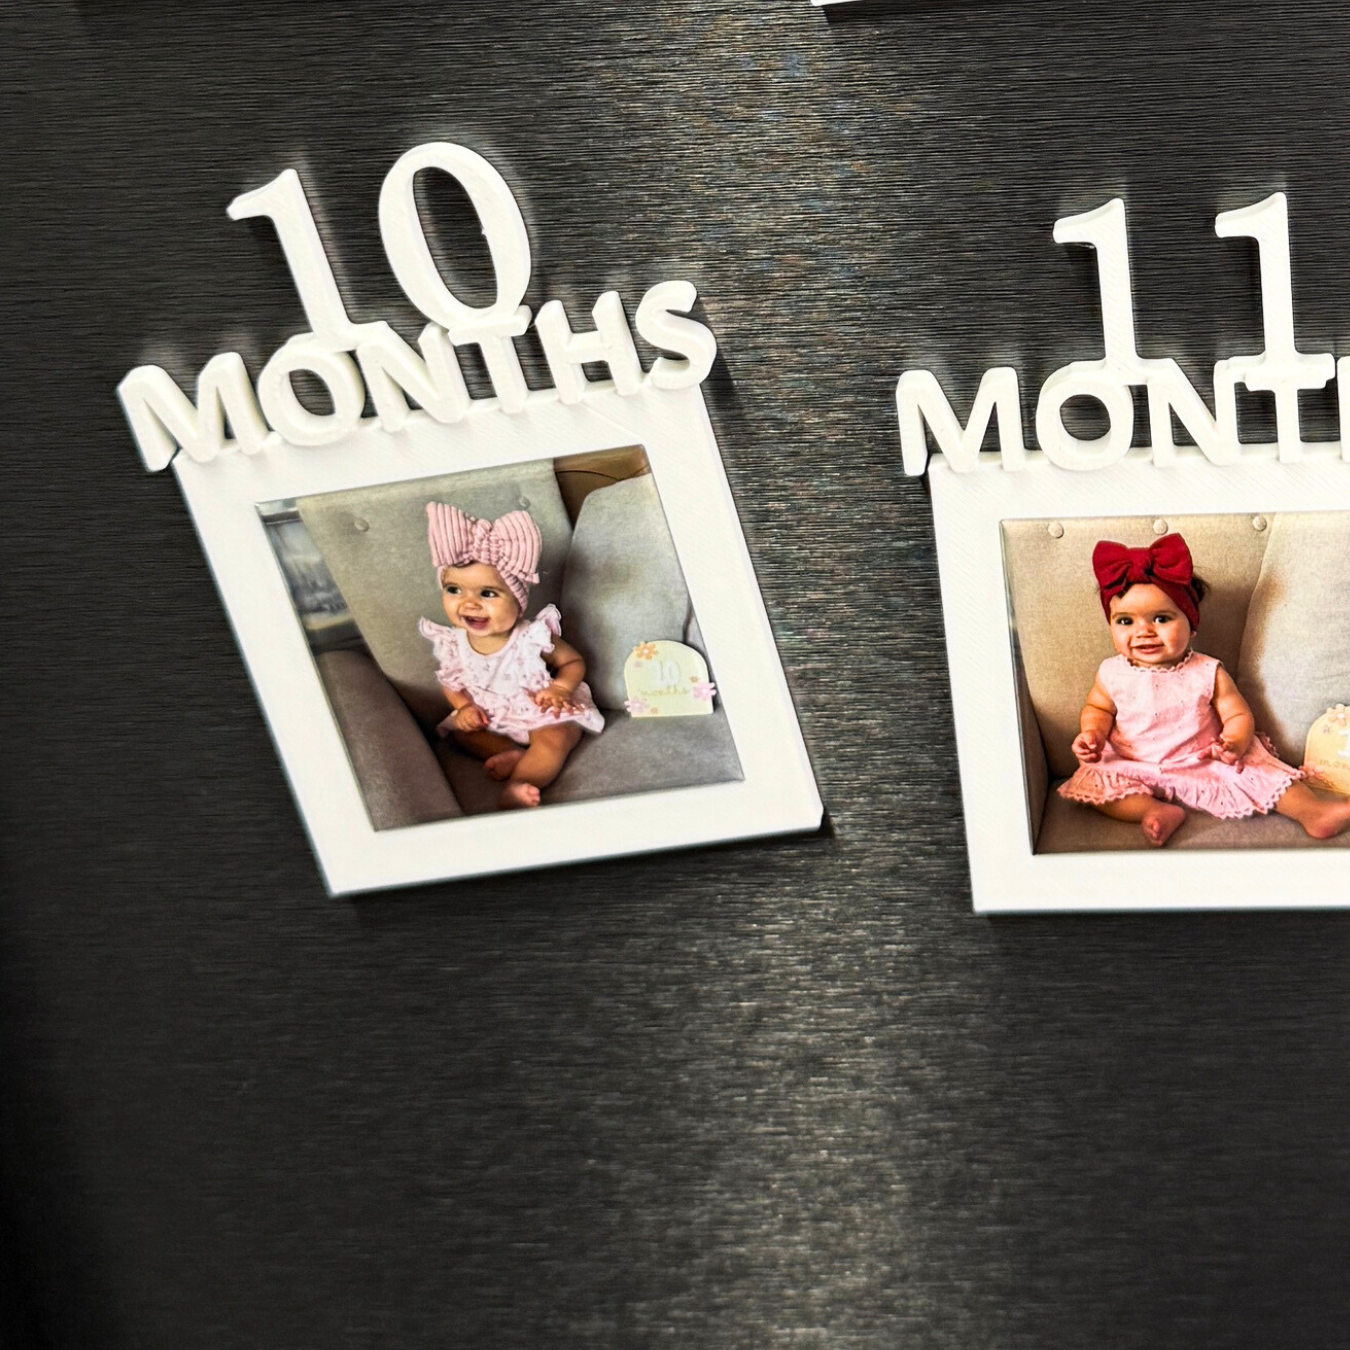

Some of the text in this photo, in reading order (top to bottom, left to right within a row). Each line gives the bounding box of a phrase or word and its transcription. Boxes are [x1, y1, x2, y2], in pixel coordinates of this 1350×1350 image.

[226, 141, 532, 350] 10
[1053, 192, 1335, 385] 11
[116, 280, 717, 472] MONTHS
